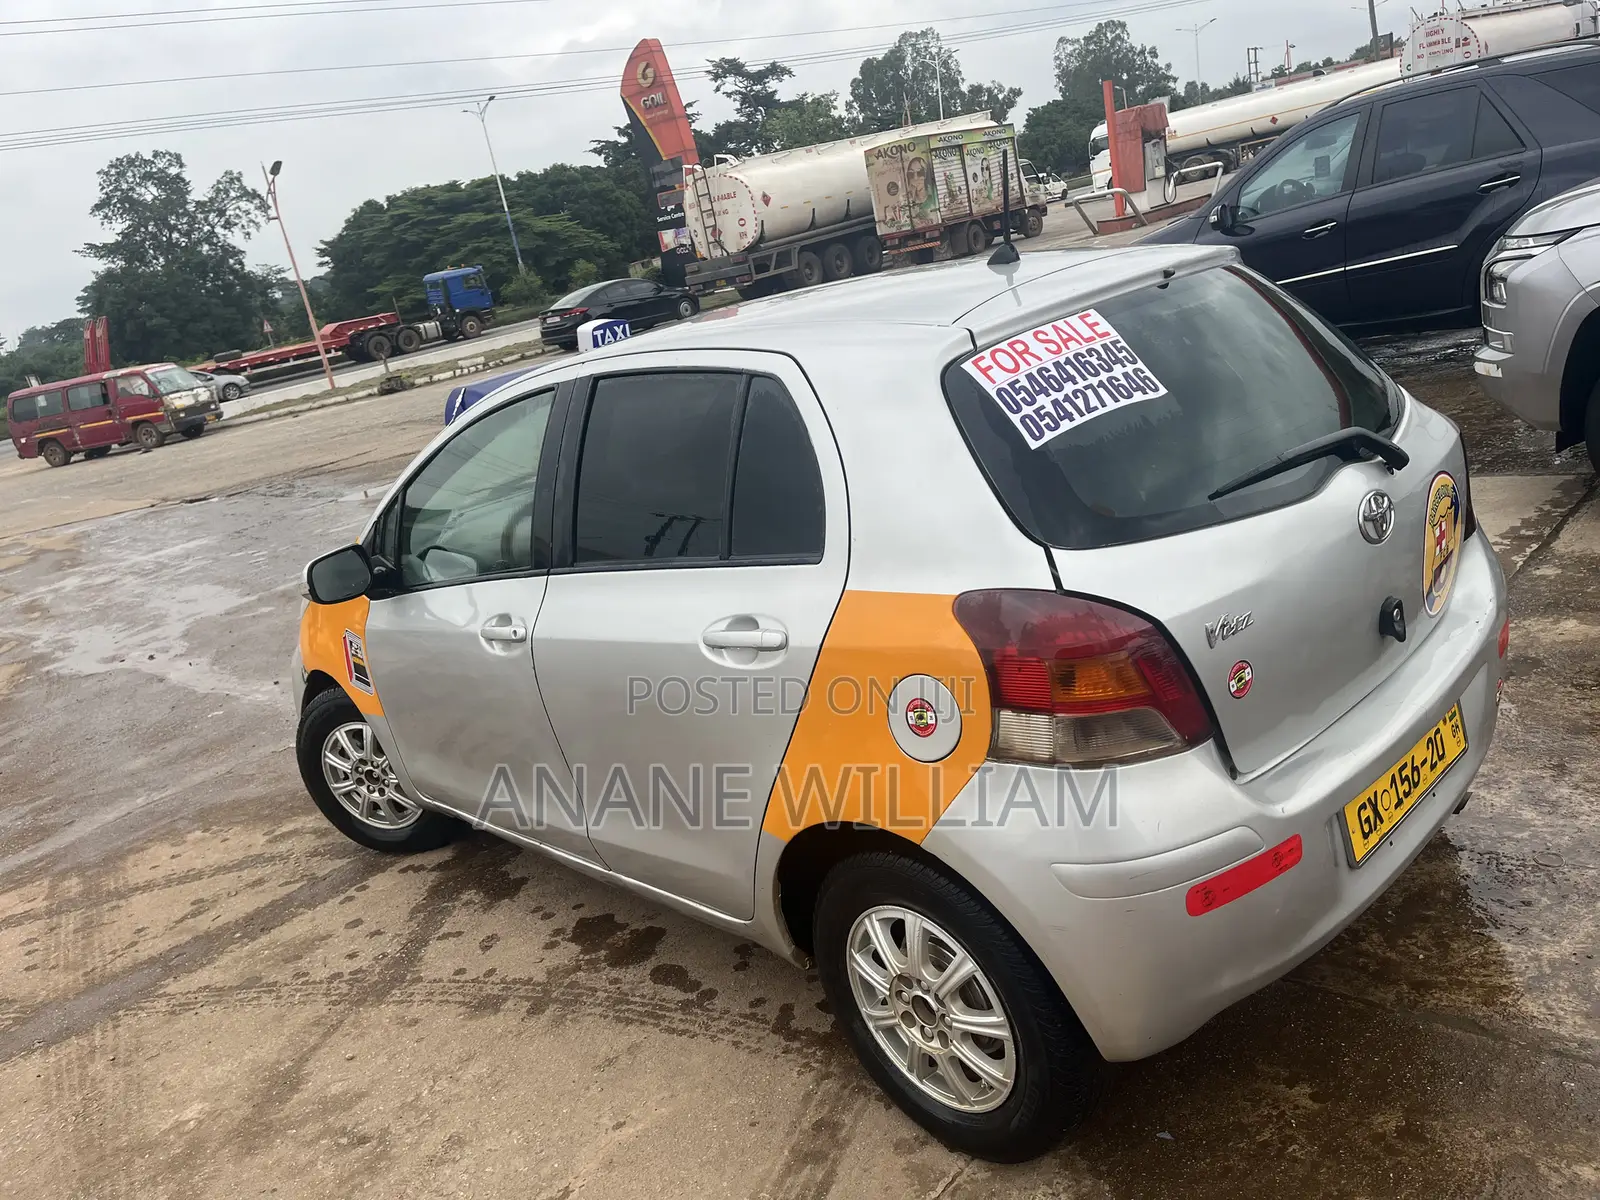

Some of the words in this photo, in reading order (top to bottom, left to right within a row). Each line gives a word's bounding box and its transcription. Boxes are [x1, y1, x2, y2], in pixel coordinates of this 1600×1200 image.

[937, 134, 964, 144] AKONO
[982, 128, 1006, 137] AKONO
[875, 142, 916, 161] AKONO
[965, 146, 985, 158] AKONO
[593, 323, 631, 347] TAXI
[971, 339, 1043, 385] FOR
[1032, 312, 1112, 355] SALE
[995, 338, 1139, 415] 0546416345
[1019, 367, 1160, 442] 0541271646
